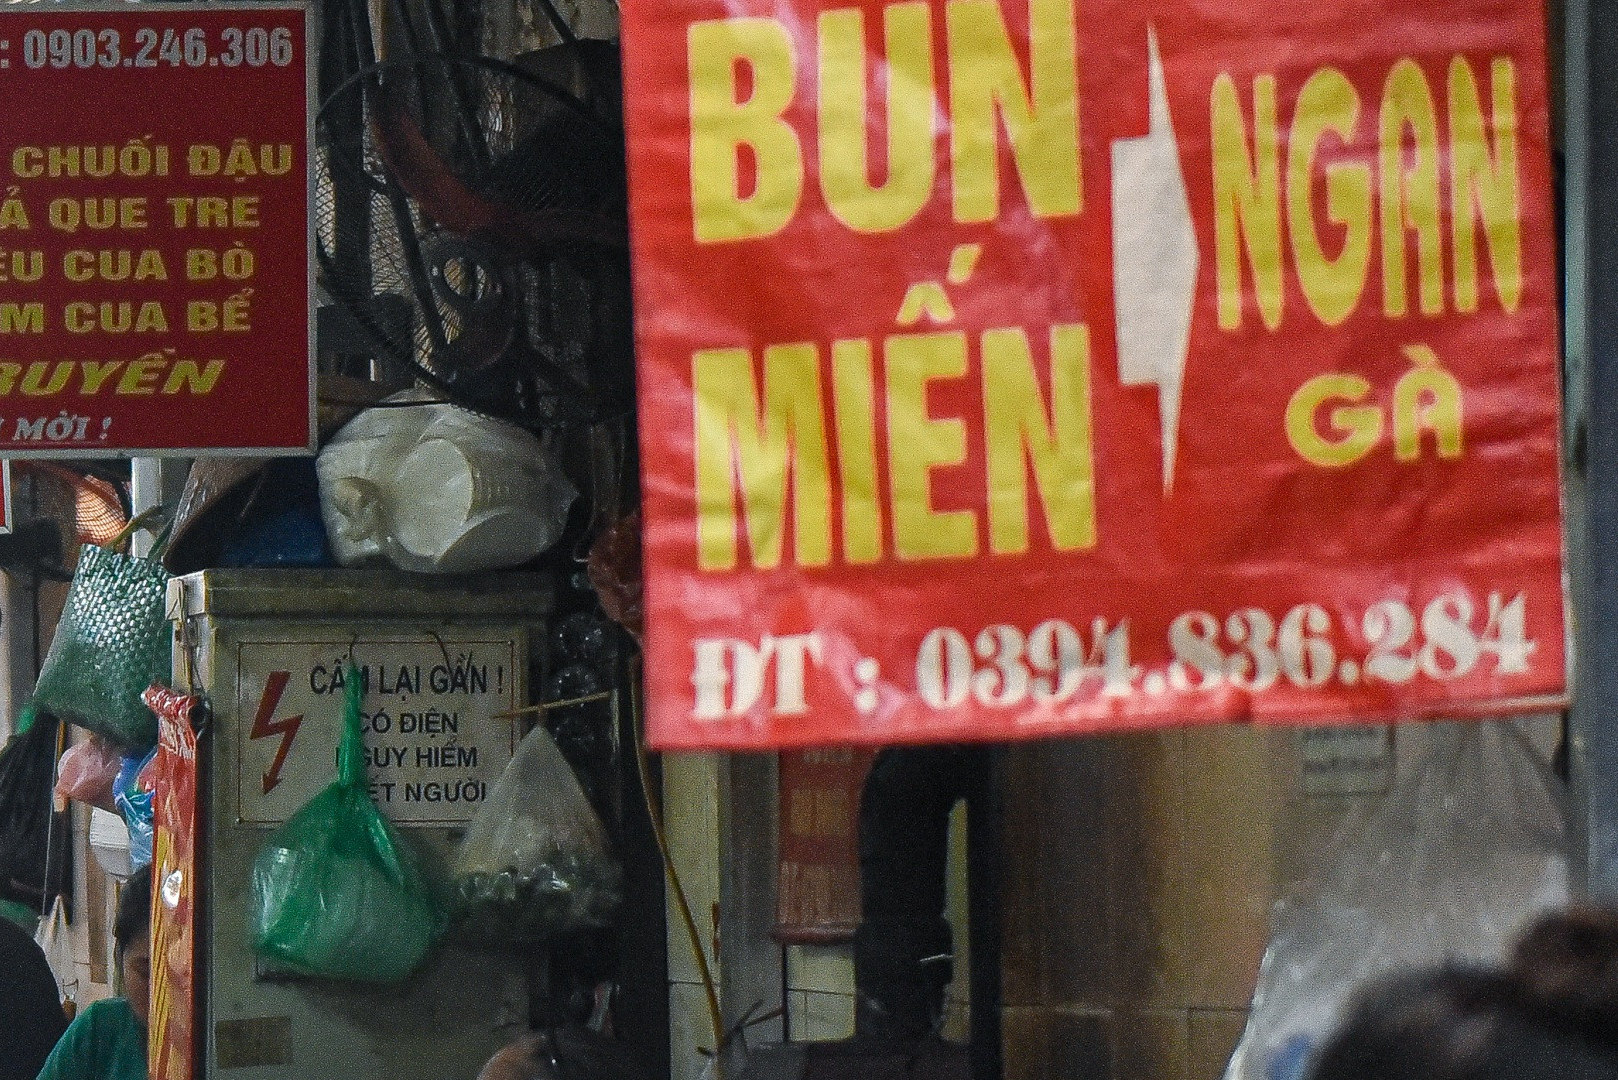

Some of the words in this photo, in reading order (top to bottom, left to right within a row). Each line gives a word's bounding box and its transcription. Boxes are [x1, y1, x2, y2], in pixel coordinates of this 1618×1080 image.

[23, 28, 294, 69] 0903.246.306
[12, 134, 168, 177] CHUỐI
[188, 138, 293, 184] ĐẬU
[1208, 54, 1522, 332] NGAN
[49, 198, 147, 233] QUE
[168, 198, 260, 229] TRE
[63, 250, 167, 282] CUA
[187, 243, 255, 281] BÒ
[64, 303, 168, 334] CUA
[692, 246, 1097, 570] MIẾN
[1285, 344, 1464, 467] GÀ
[15, 411, 90, 441] MỜI
[690, 632, 822, 720] ĐT
[915, 590, 1537, 710] 0394.836.284
[309, 654, 369, 696] CẤ
[378, 666, 420, 702] LẠI
[429, 654, 487, 696] GẦN
[399, 711, 459, 738] ĐIỆN
[415, 738, 479, 768] HIỂM
[404, 778, 487, 802] NGƯỜI
